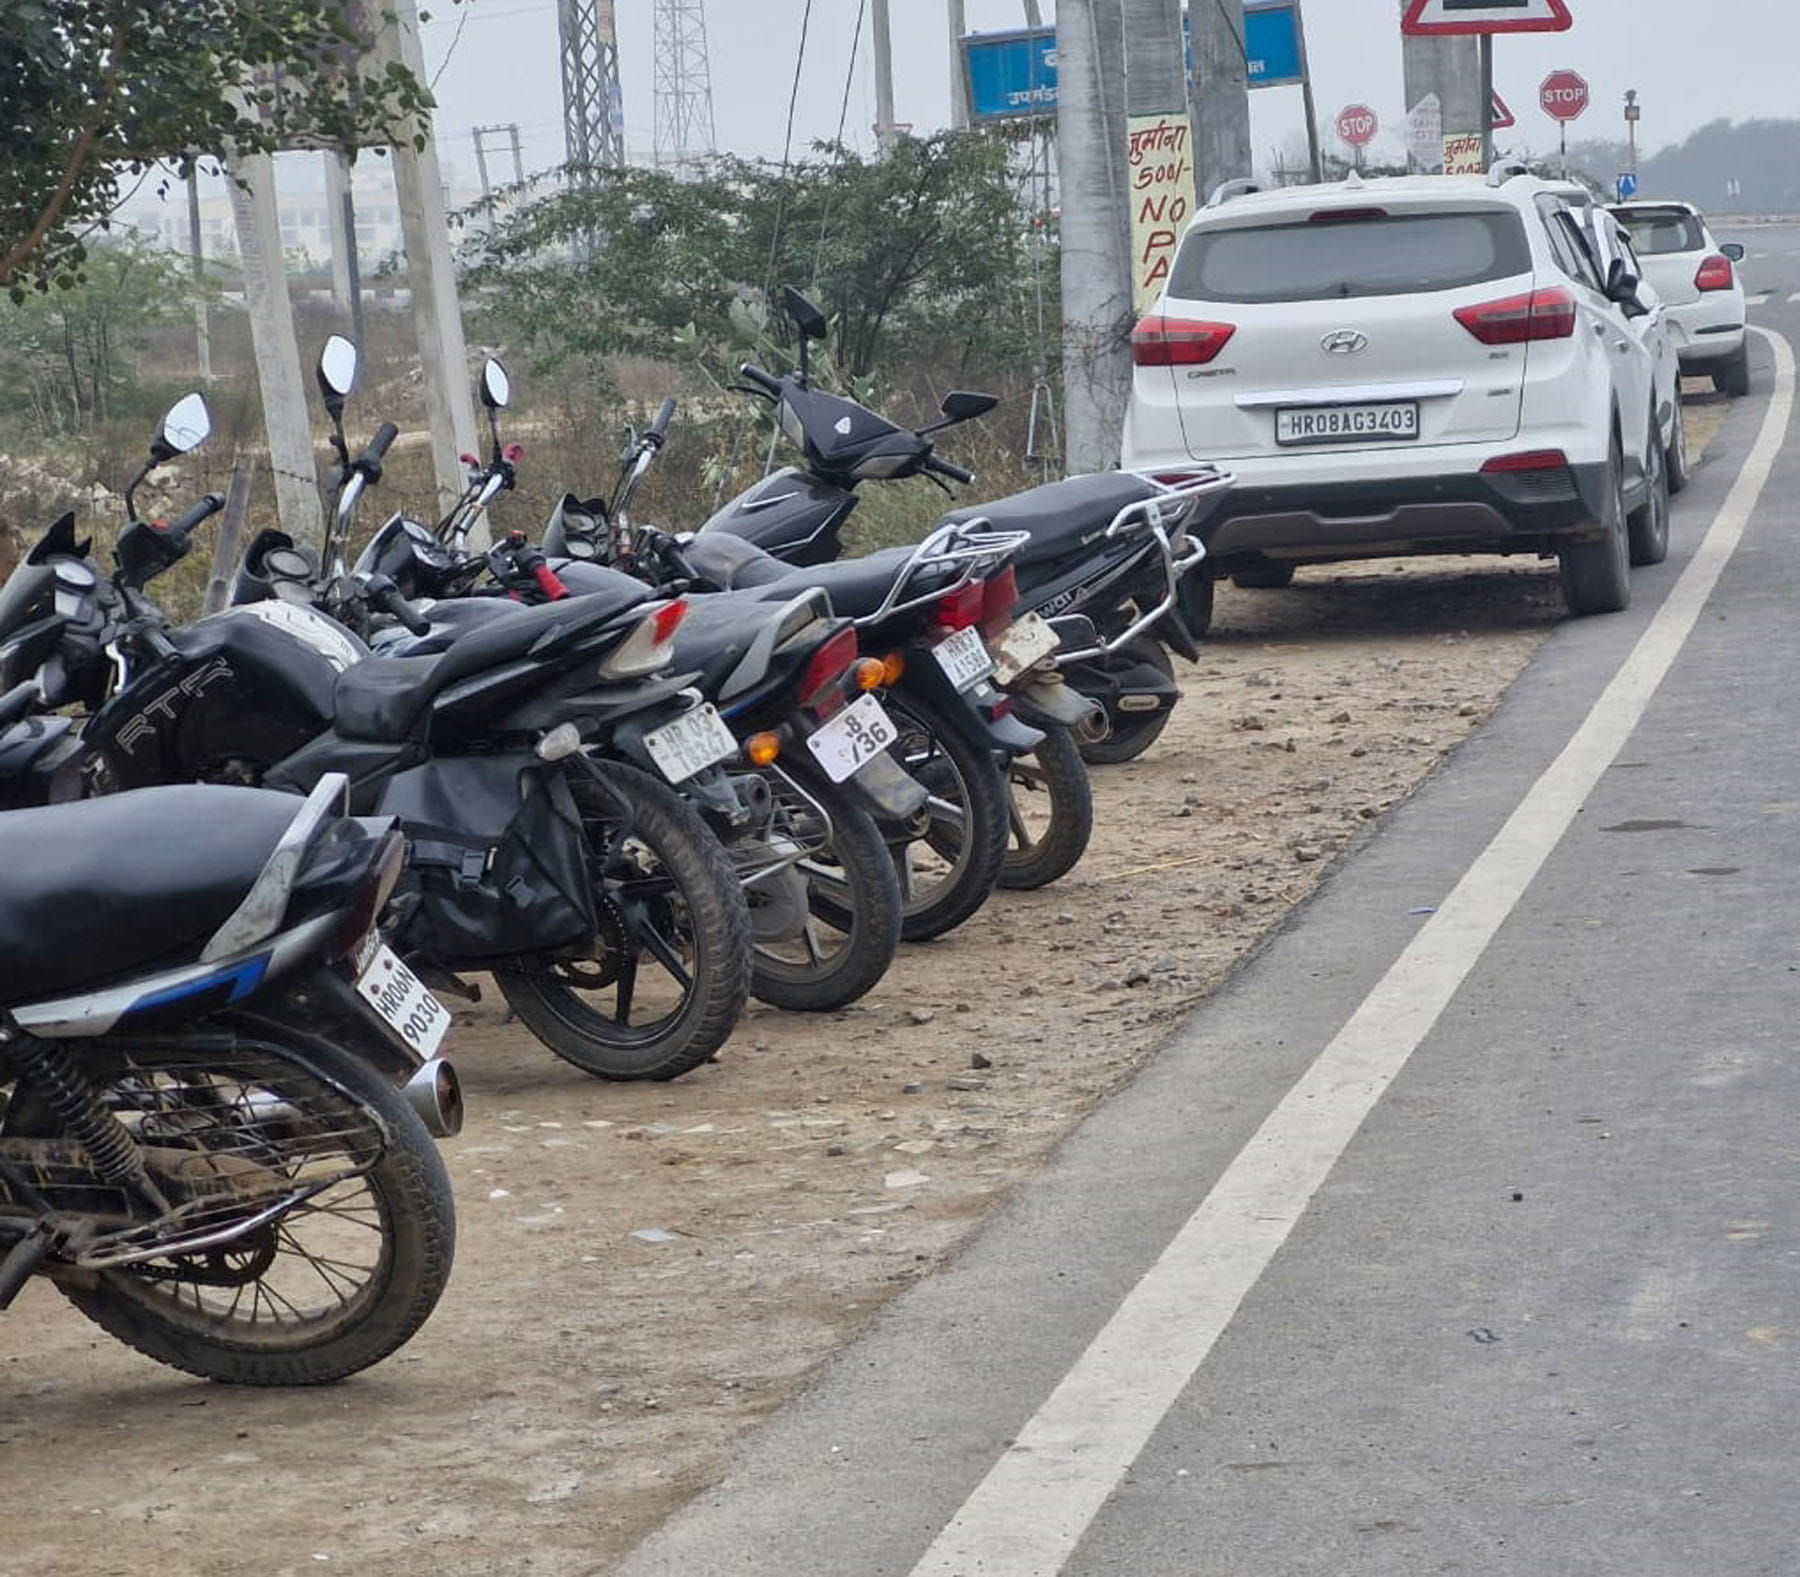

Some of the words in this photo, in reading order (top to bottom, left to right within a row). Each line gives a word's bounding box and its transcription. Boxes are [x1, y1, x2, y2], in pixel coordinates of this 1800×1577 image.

[1542, 88, 1584, 103] STOP
[1341, 115, 1373, 136] STOP
[1138, 194, 1187, 223] NO
[1291, 409, 1415, 435] HR08AG3403
[115, 655, 234, 756] RTR
[376, 965, 417, 1020] HR06N
[402, 993, 440, 1044] 9030
